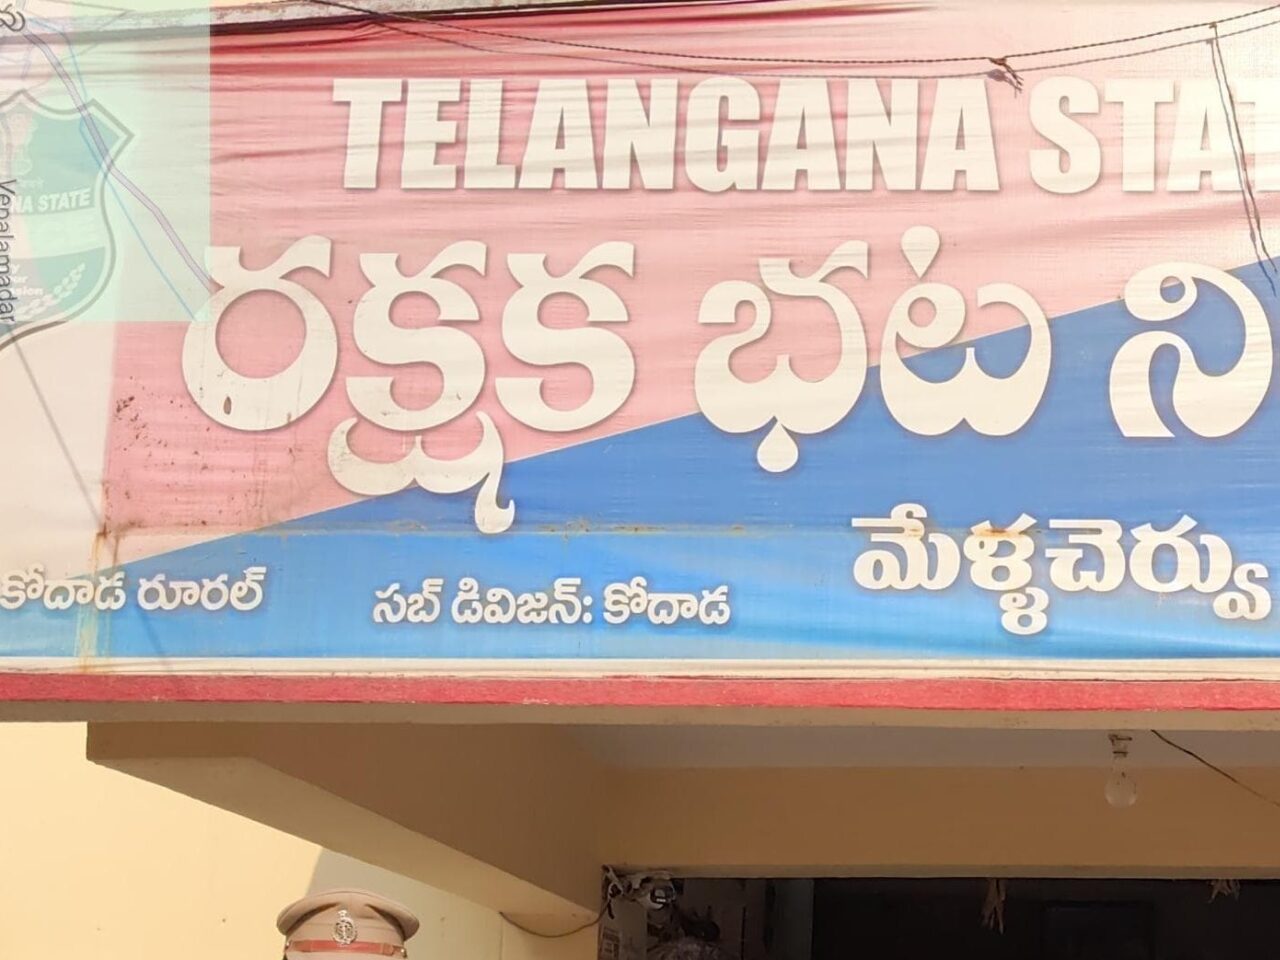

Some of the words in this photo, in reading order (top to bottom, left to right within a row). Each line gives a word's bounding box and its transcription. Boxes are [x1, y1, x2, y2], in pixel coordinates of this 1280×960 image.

[332, 77, 1000, 193] TELANGANA
[37, 187, 92, 211] STATE
[182, 234, 637, 534] రక్షక
[694, 226, 1052, 472] భట
[137, 566, 267, 611] రూరల్
[372, 578, 444, 623] సబ్
[451, 577, 593, 625] డివిజన్:
[603, 576, 731, 625] కోదాడ
